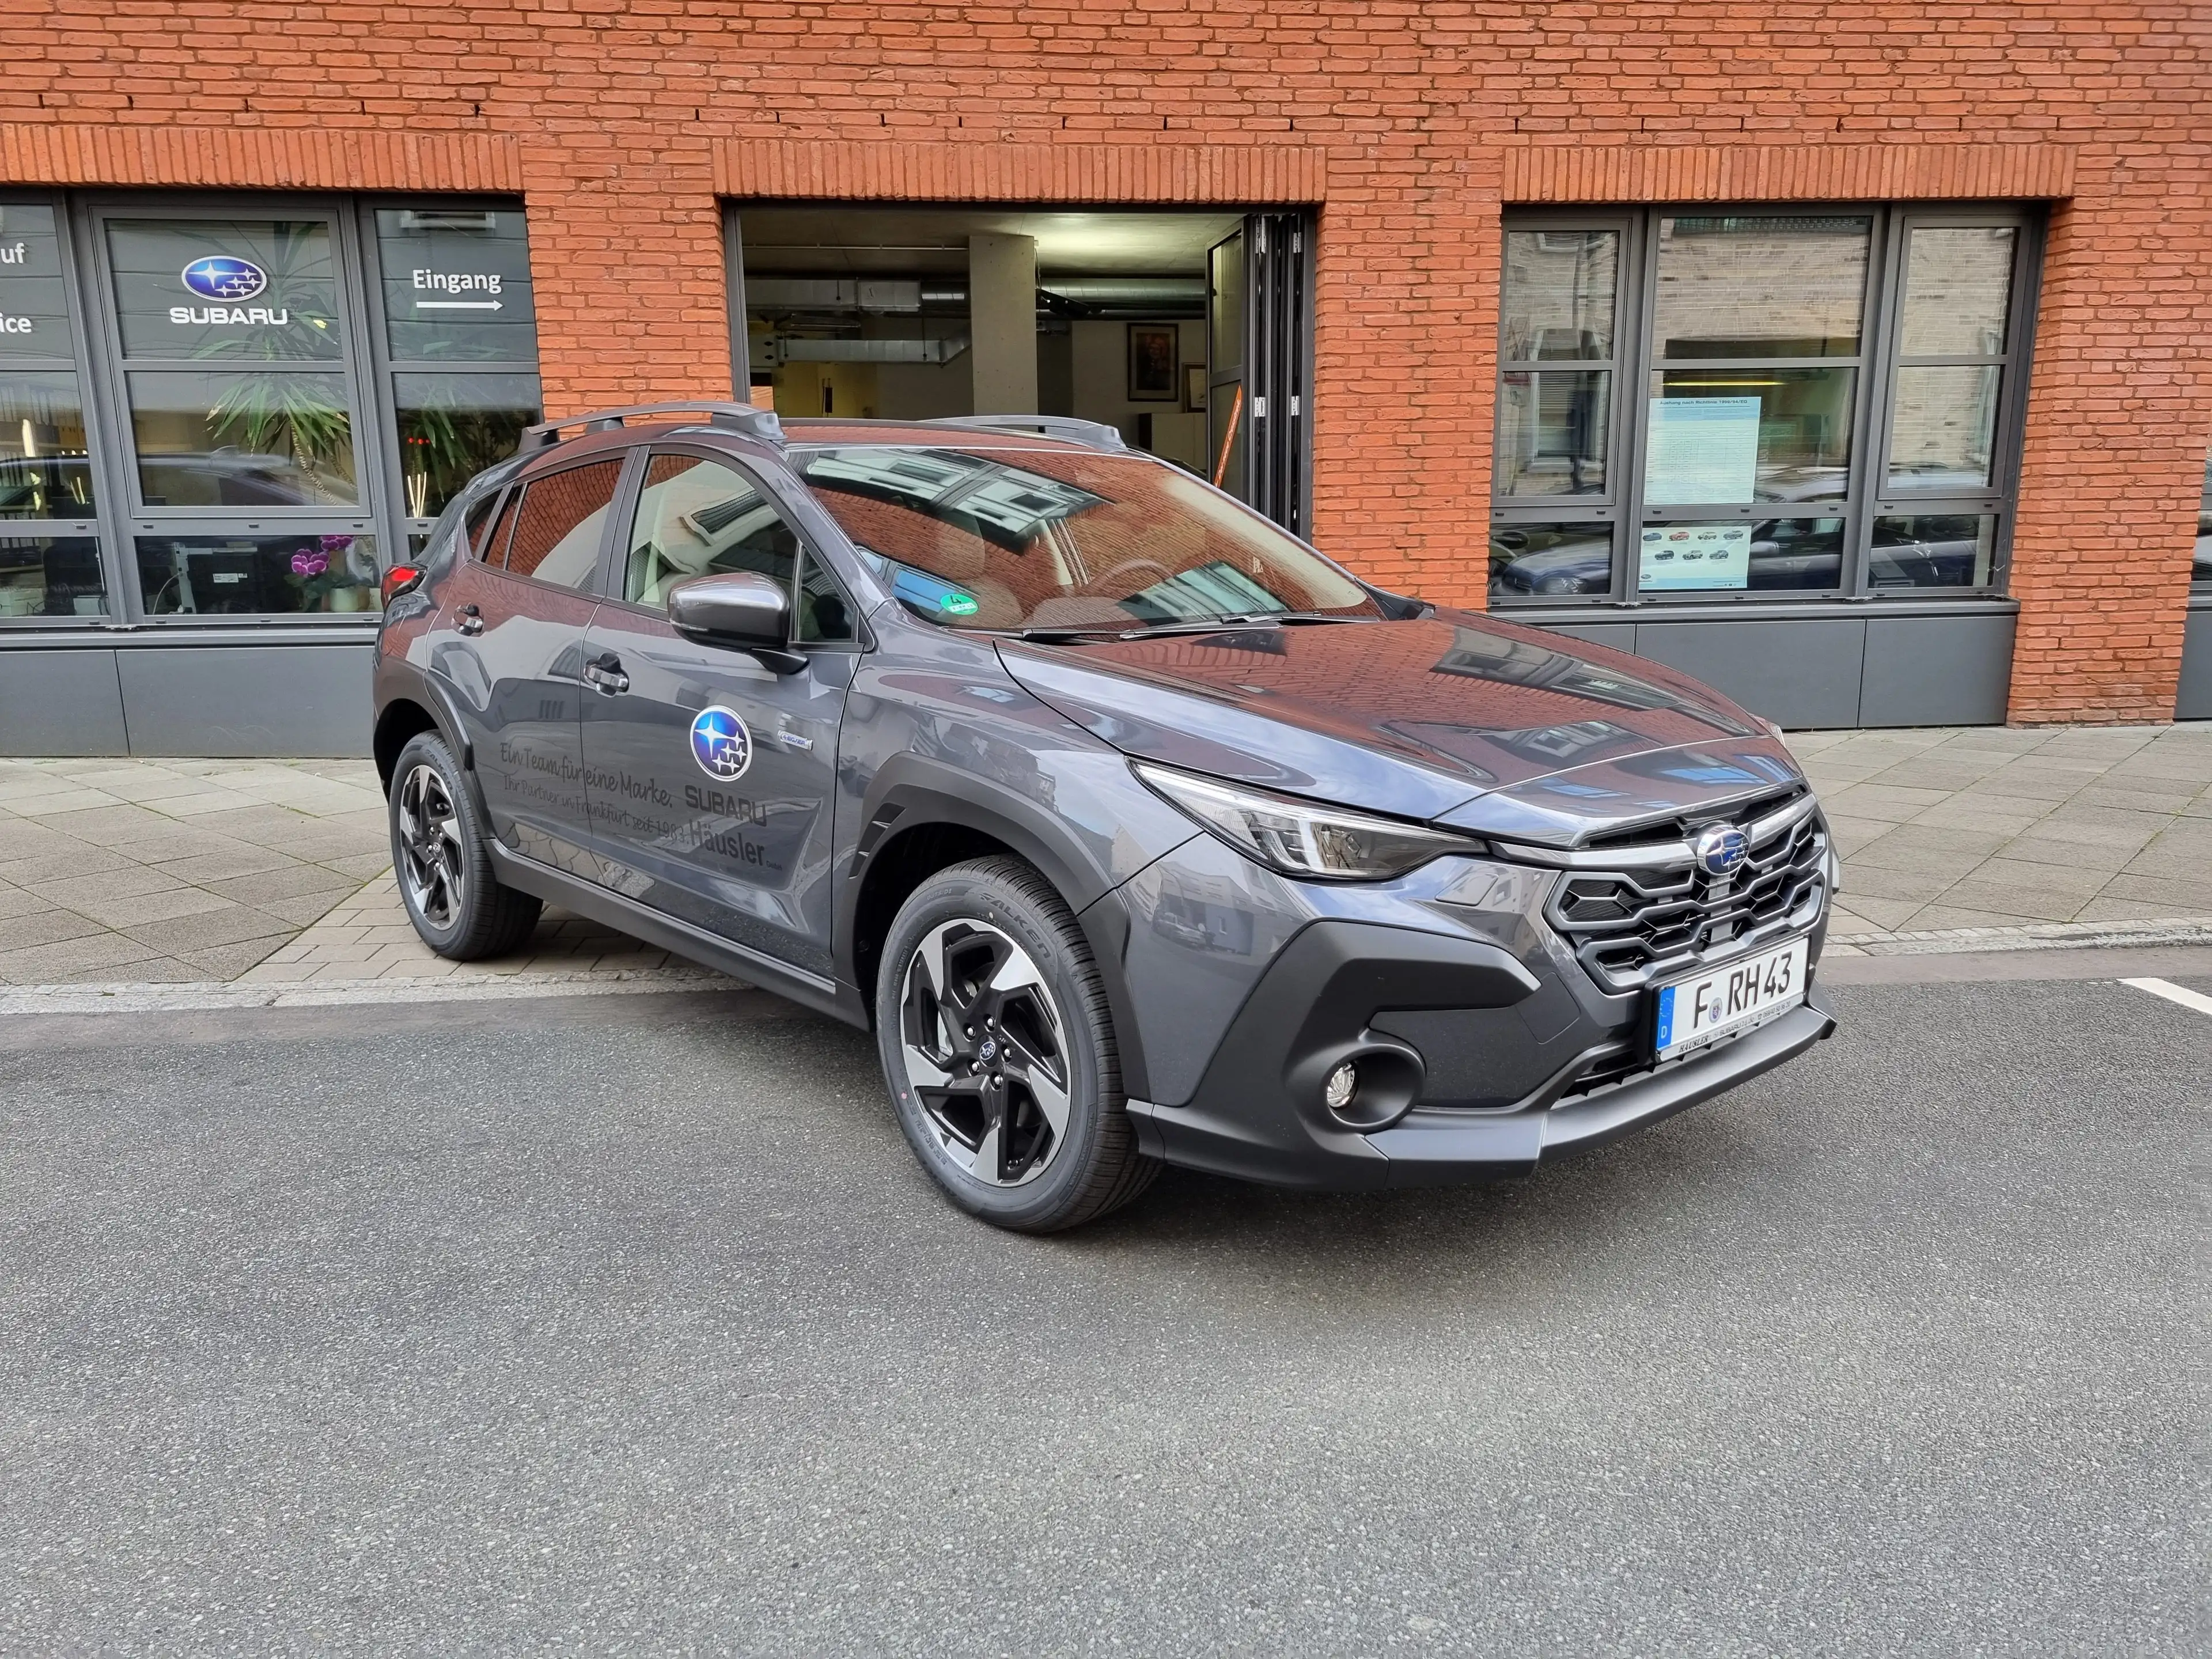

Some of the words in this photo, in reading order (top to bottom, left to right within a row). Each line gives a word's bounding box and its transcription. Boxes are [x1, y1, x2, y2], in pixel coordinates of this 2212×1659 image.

[413, 269, 502, 294] Eingang
[169, 307, 288, 325] SUBARU
[950, 595, 961, 604] 4
[500, 742, 523, 765] Ein
[524, 748, 560, 776] Team
[560, 755, 582, 783] für
[585, 767, 619, 791] eine
[620, 771, 673, 808] Marke.
[503, 775, 519, 791] Ihr
[521, 780, 558, 803] Partner
[562, 796, 574, 809] in
[575, 796, 630, 826] Frankfurt
[632, 816, 653, 833] seit
[685, 785, 767, 827] SUBARU
[689, 819, 764, 866] Häusler
[980, 892, 1052, 959] FALKEN
[1694, 979, 1712, 1029] F
[1661, 1025, 1668, 1039] D
